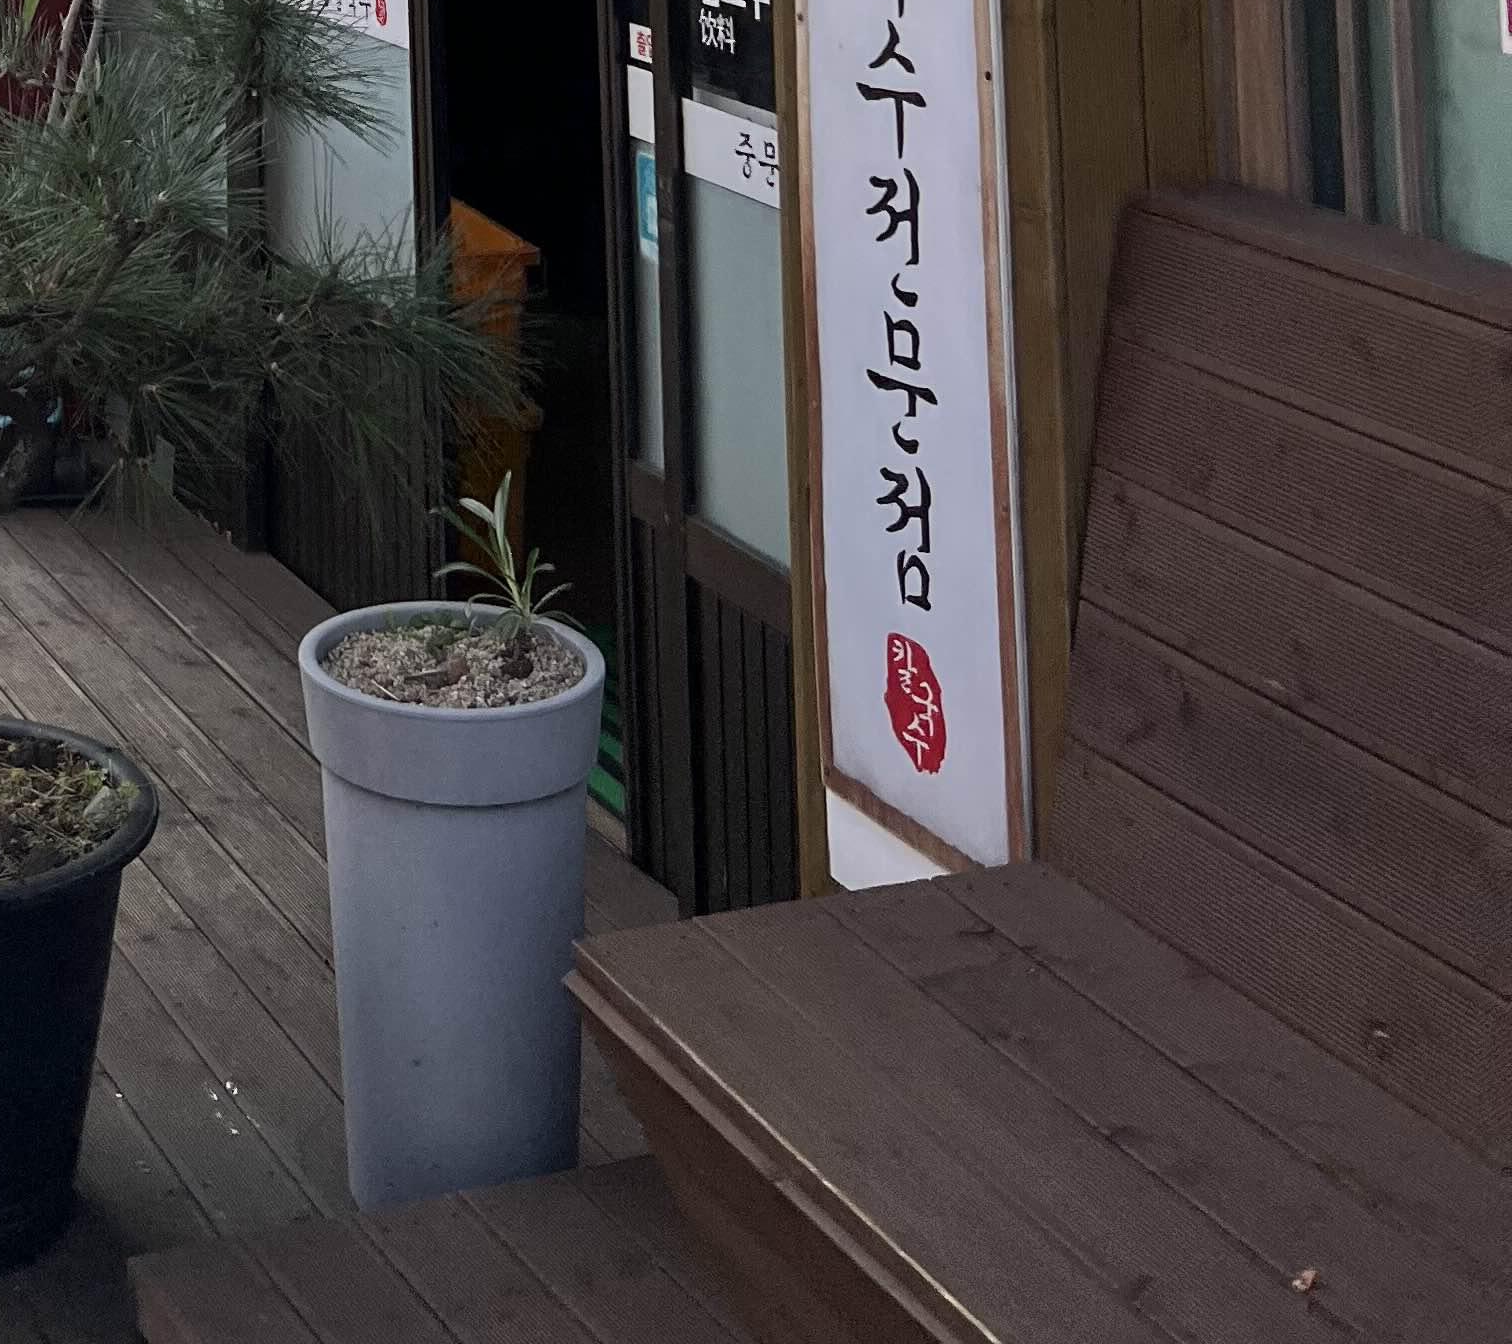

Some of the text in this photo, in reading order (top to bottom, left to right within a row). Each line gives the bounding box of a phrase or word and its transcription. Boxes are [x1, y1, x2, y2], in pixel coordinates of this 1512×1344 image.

[698, 8, 737, 55] 饮料
[735, 132, 782, 188] 중문
[891, 638, 939, 767] 칼국수
